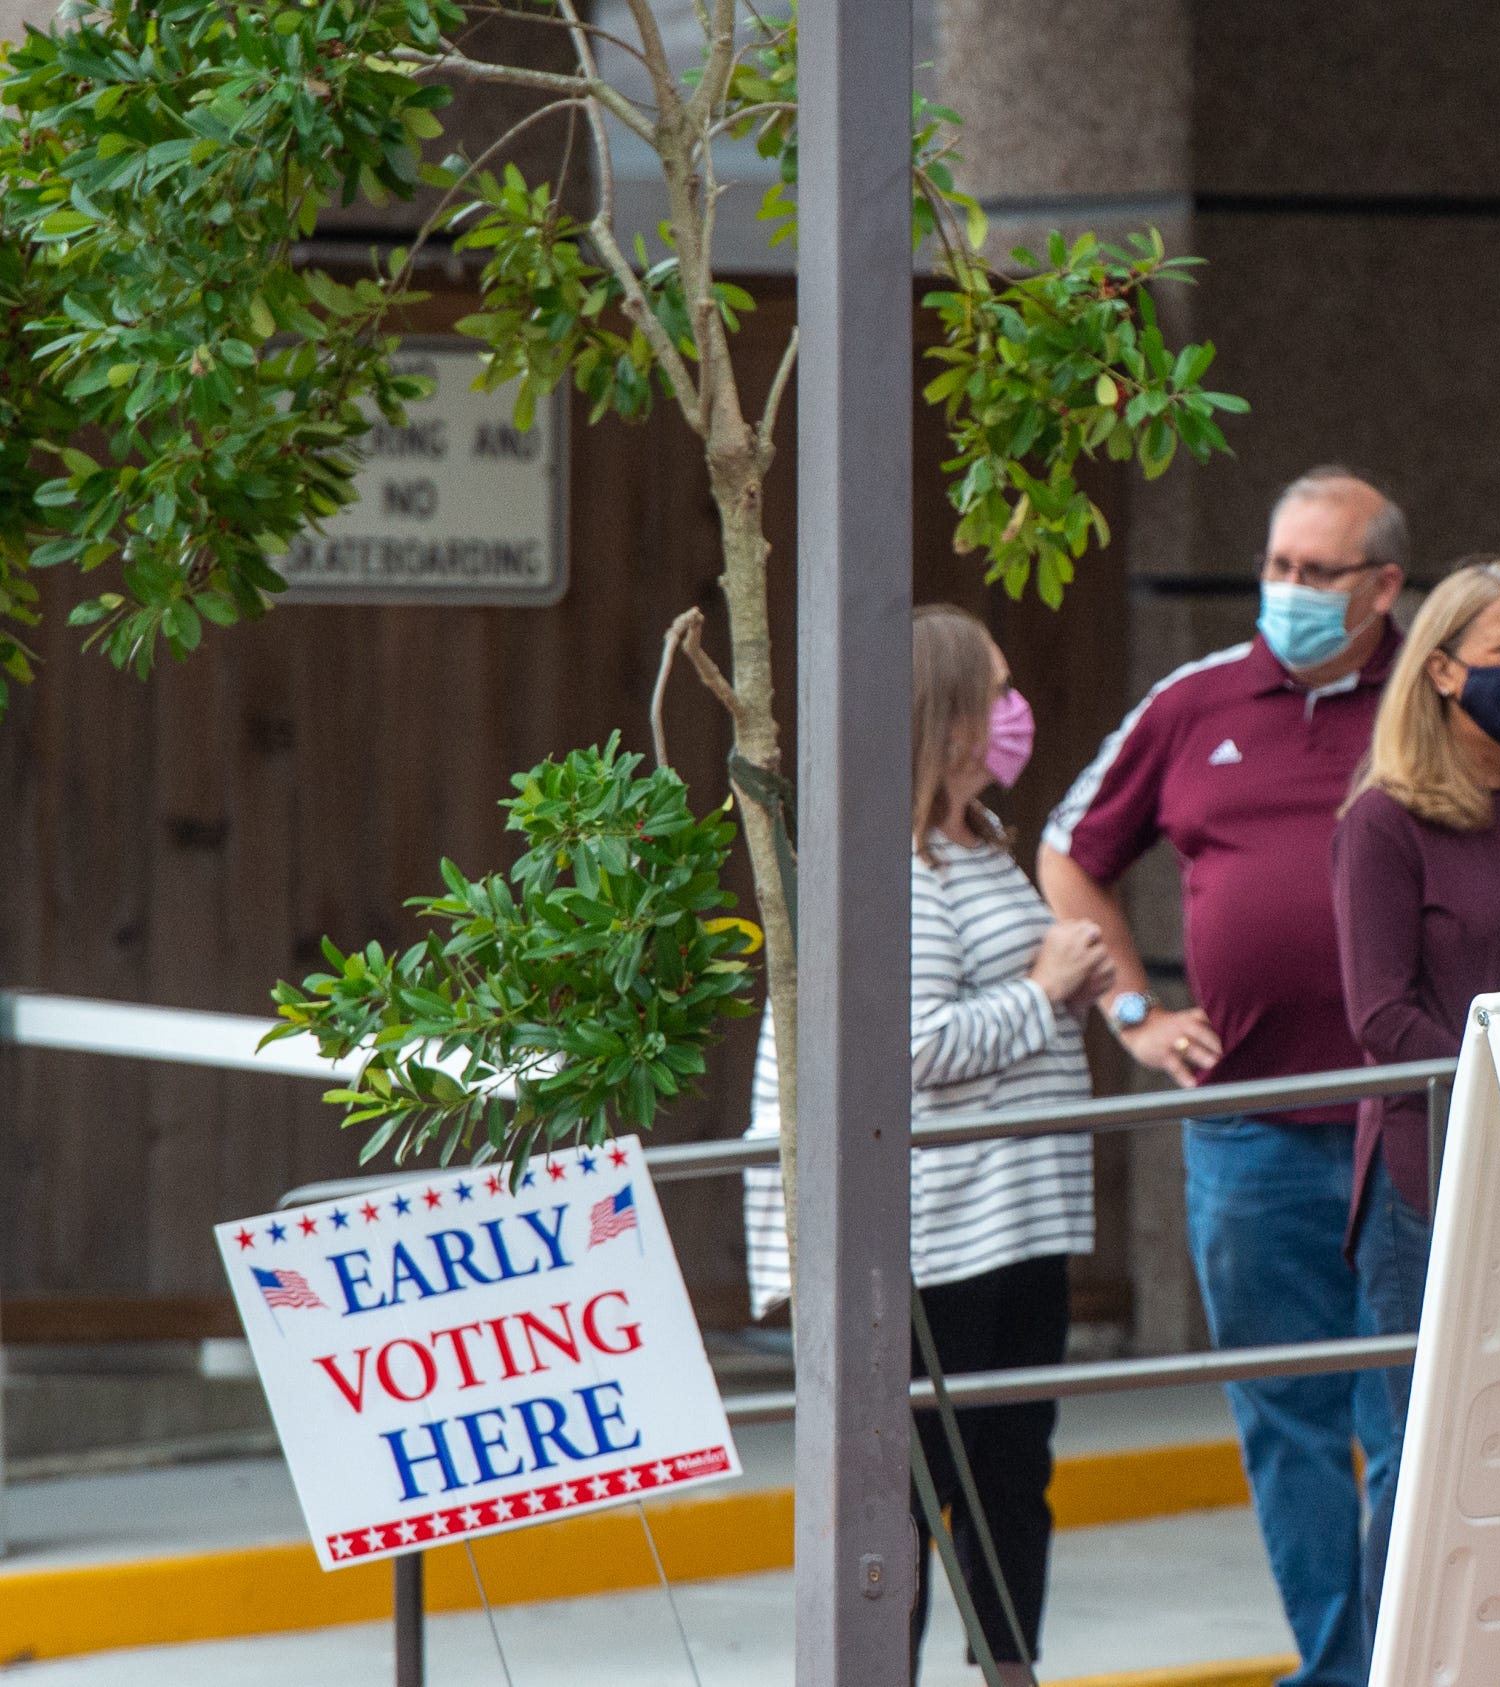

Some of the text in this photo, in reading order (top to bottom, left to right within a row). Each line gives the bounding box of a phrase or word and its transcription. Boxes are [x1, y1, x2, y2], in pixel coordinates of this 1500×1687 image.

[474, 421, 540, 460] AND
[382, 478, 438, 520] NO
[326, 1204, 575, 1316] EARLY
[313, 1290, 644, 1415] VOTING
[380, 1380, 641, 1502] HERE
